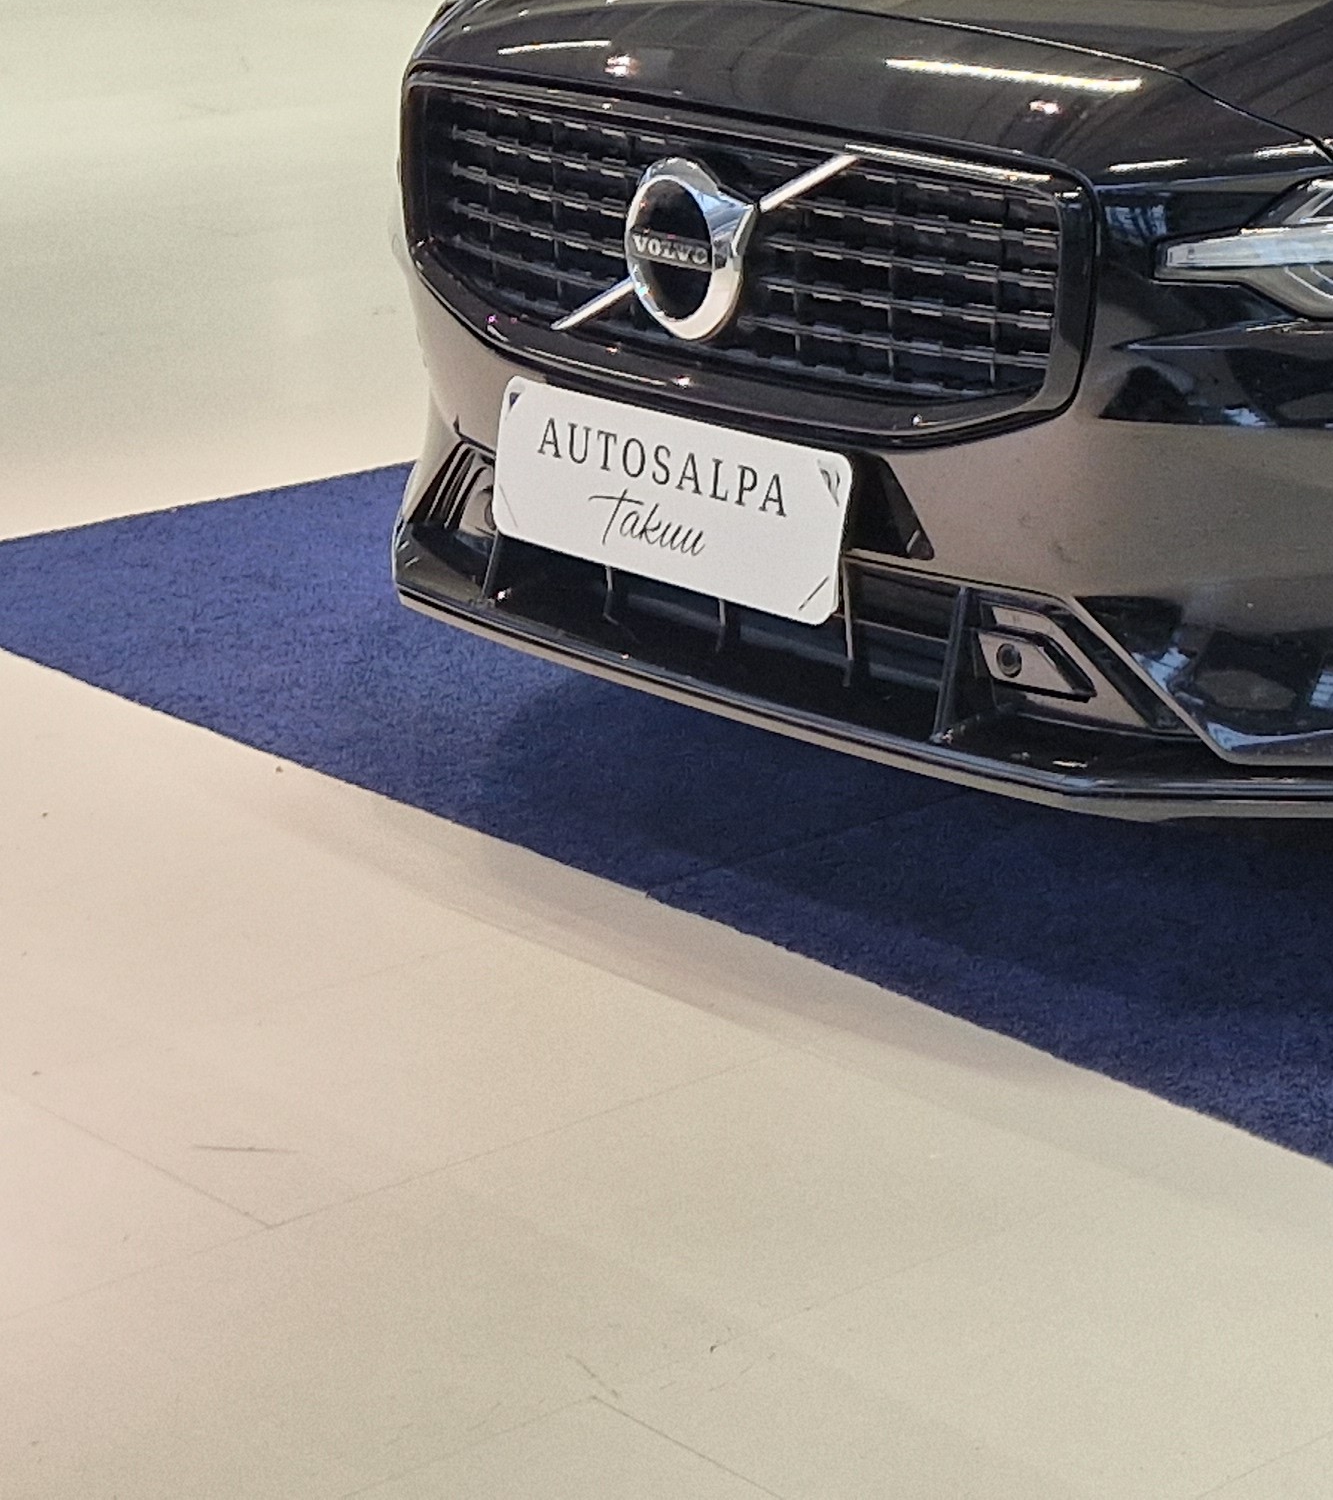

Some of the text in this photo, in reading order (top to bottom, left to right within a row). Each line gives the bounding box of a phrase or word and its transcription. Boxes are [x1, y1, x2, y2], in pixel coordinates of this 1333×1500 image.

[631, 232, 709, 265] VOLVO
[537, 417, 787, 517] AUTOSALPA
[588, 488, 705, 557] Takuu
